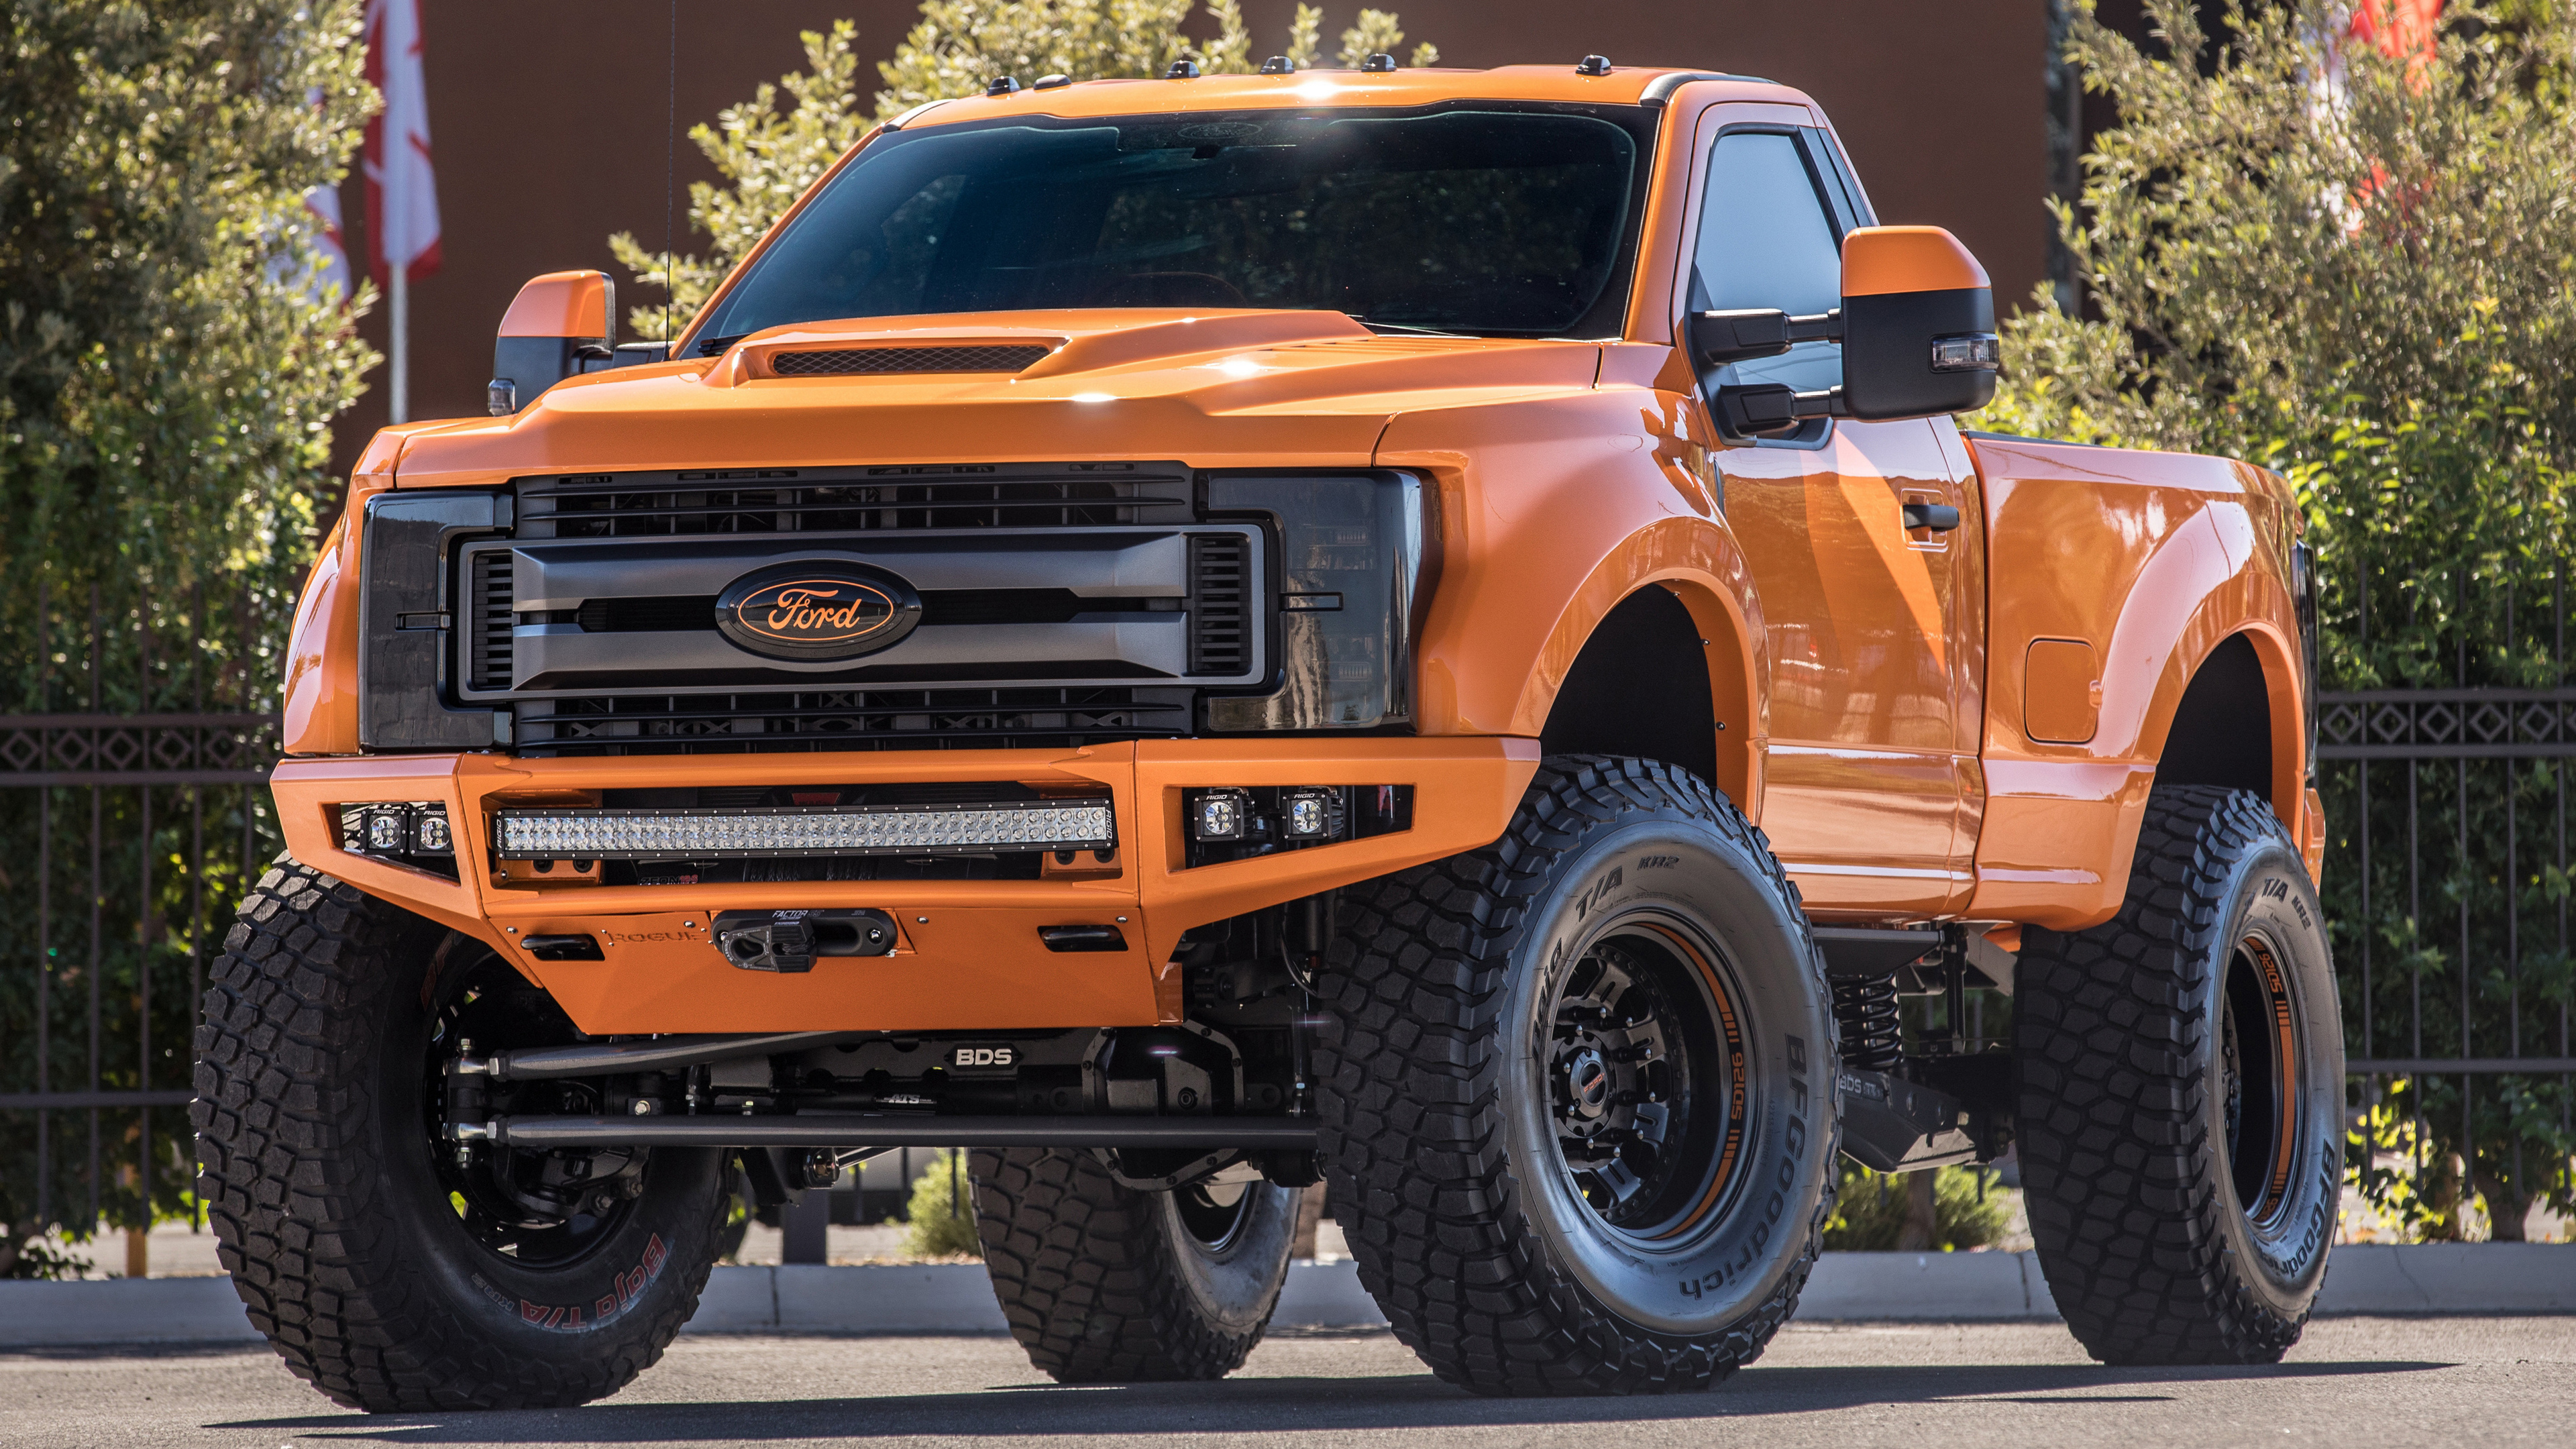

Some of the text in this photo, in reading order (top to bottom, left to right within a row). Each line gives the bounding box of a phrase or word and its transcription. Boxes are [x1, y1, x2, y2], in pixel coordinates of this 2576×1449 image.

[768, 588, 862, 630] Ford
[1576, 865, 1623, 922] T/A
[1638, 855, 1680, 871] KR2
[2261, 877, 2289, 903] T/A
[2292, 894, 2312, 931] KR2
[771, 910, 809, 918] FACTOR
[607, 931, 704, 943] ROGUE
[956, 1049, 1012, 1065] BDS
[1839, 1074, 1862, 1094] BDS
[1679, 1033, 1808, 1300] BFGoodrich
[471, 1232, 667, 1330] Baja T/A KR2
